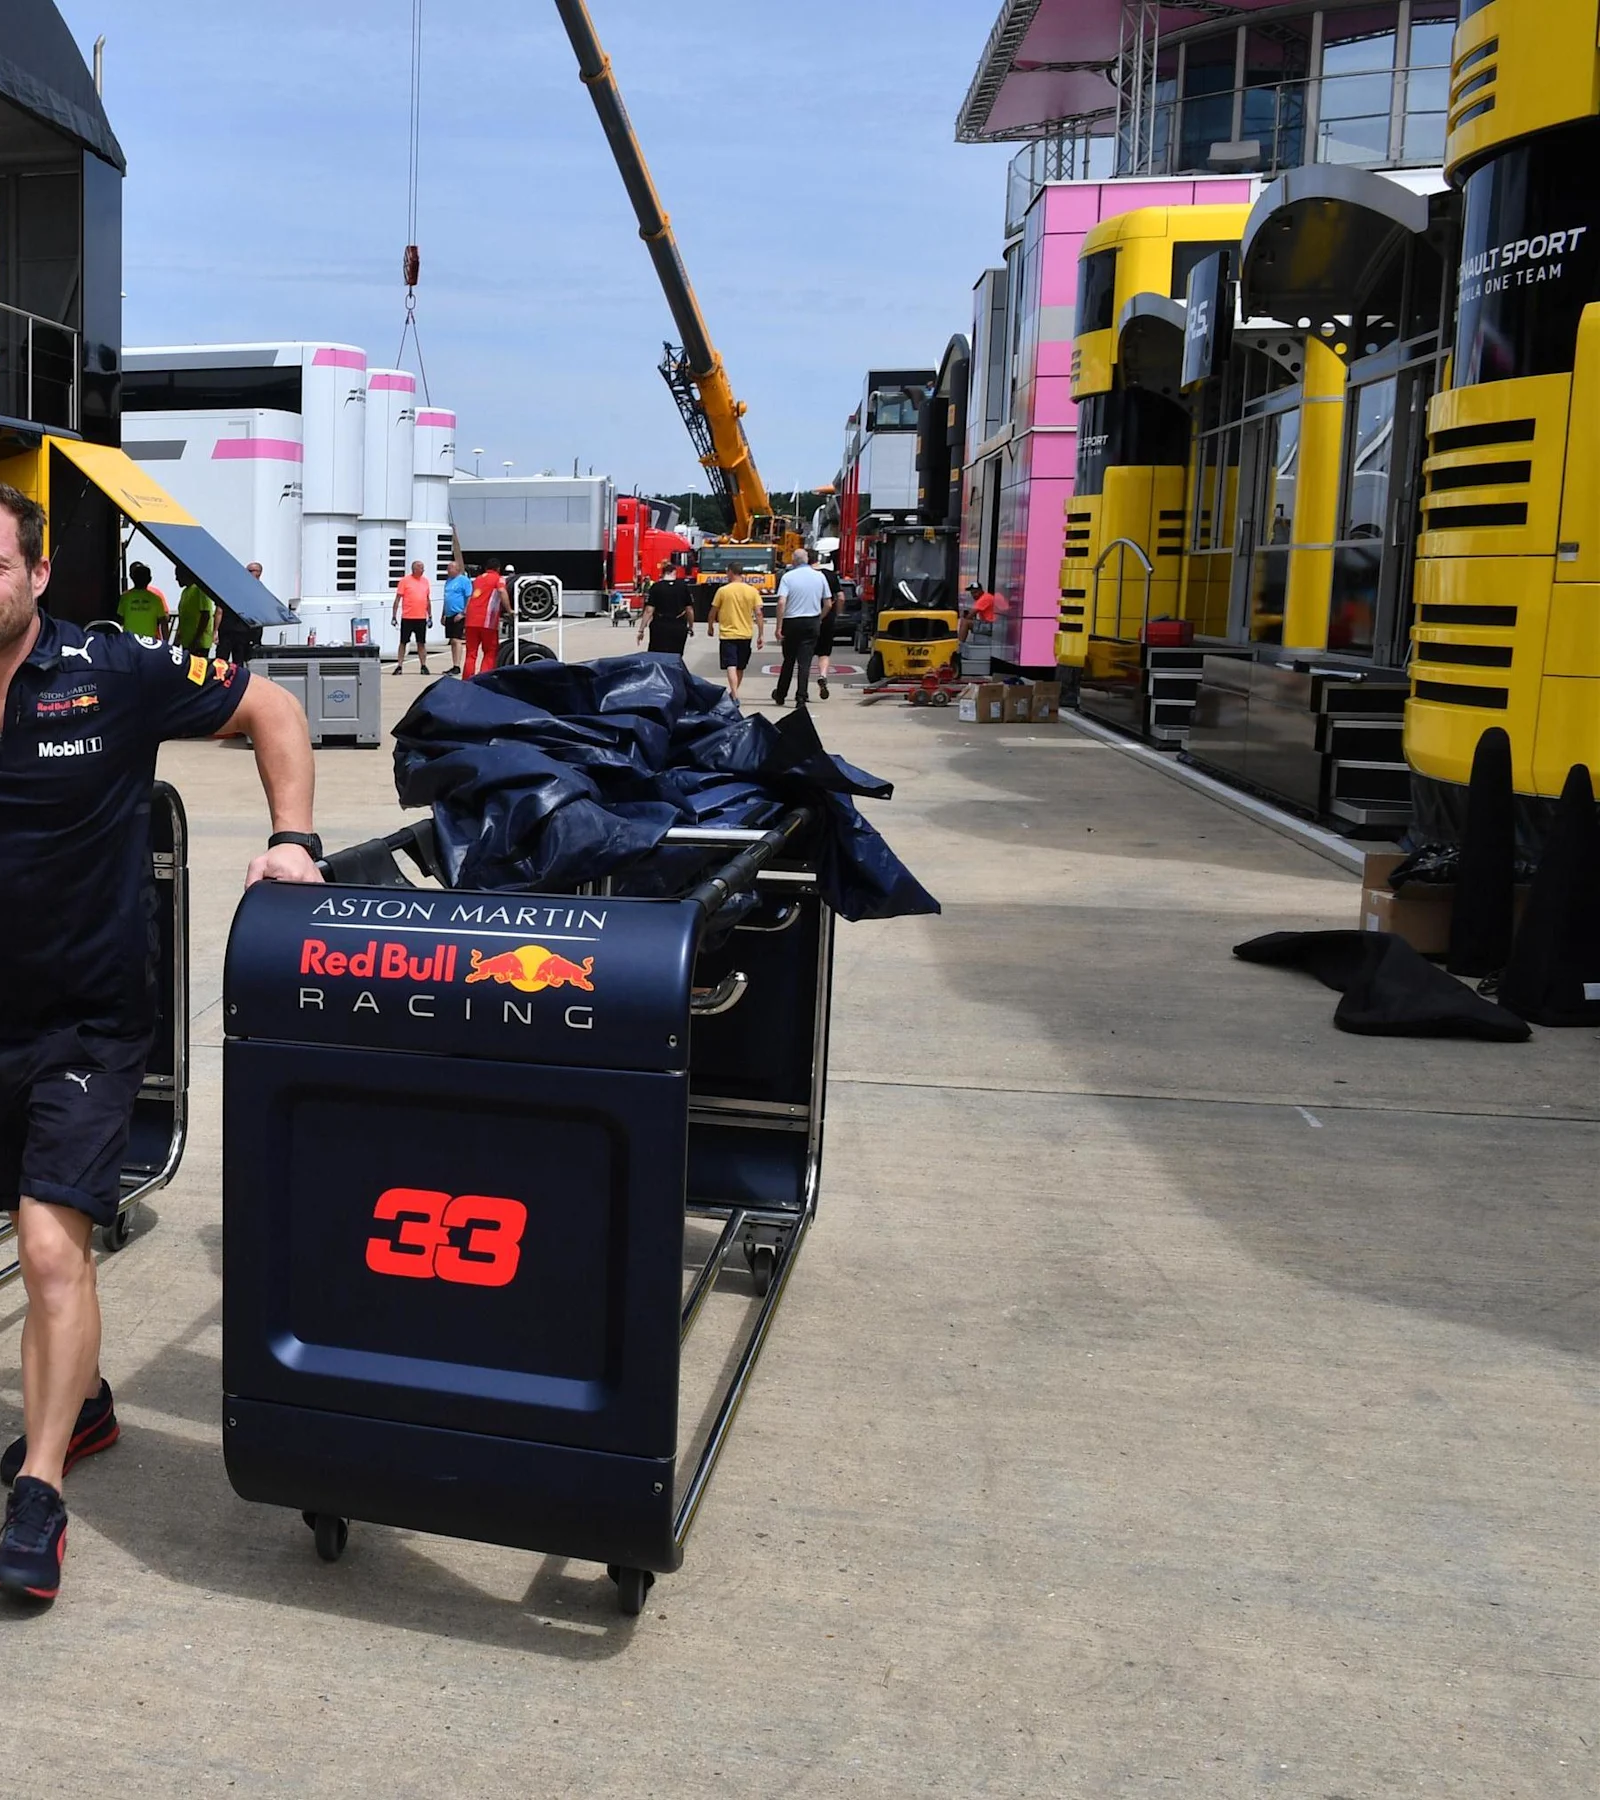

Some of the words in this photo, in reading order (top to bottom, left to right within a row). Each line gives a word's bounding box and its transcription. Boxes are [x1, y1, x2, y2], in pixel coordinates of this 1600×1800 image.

[1500, 226, 1587, 267] SPORT
[1484, 273, 1512, 295] ONE
[1516, 263, 1562, 286] TEAM
[37, 705, 100, 718] RACING
[39, 692, 65, 700] ASTON
[38, 739, 85, 758] Mobil
[312, 897, 436, 921] ASTON
[450, 904, 608, 931] MARTIN
[299, 938, 378, 980] Red
[379, 942, 458, 983] Bull
[299, 987, 594, 1030] RACING
[365, 1187, 528, 1287] 33
